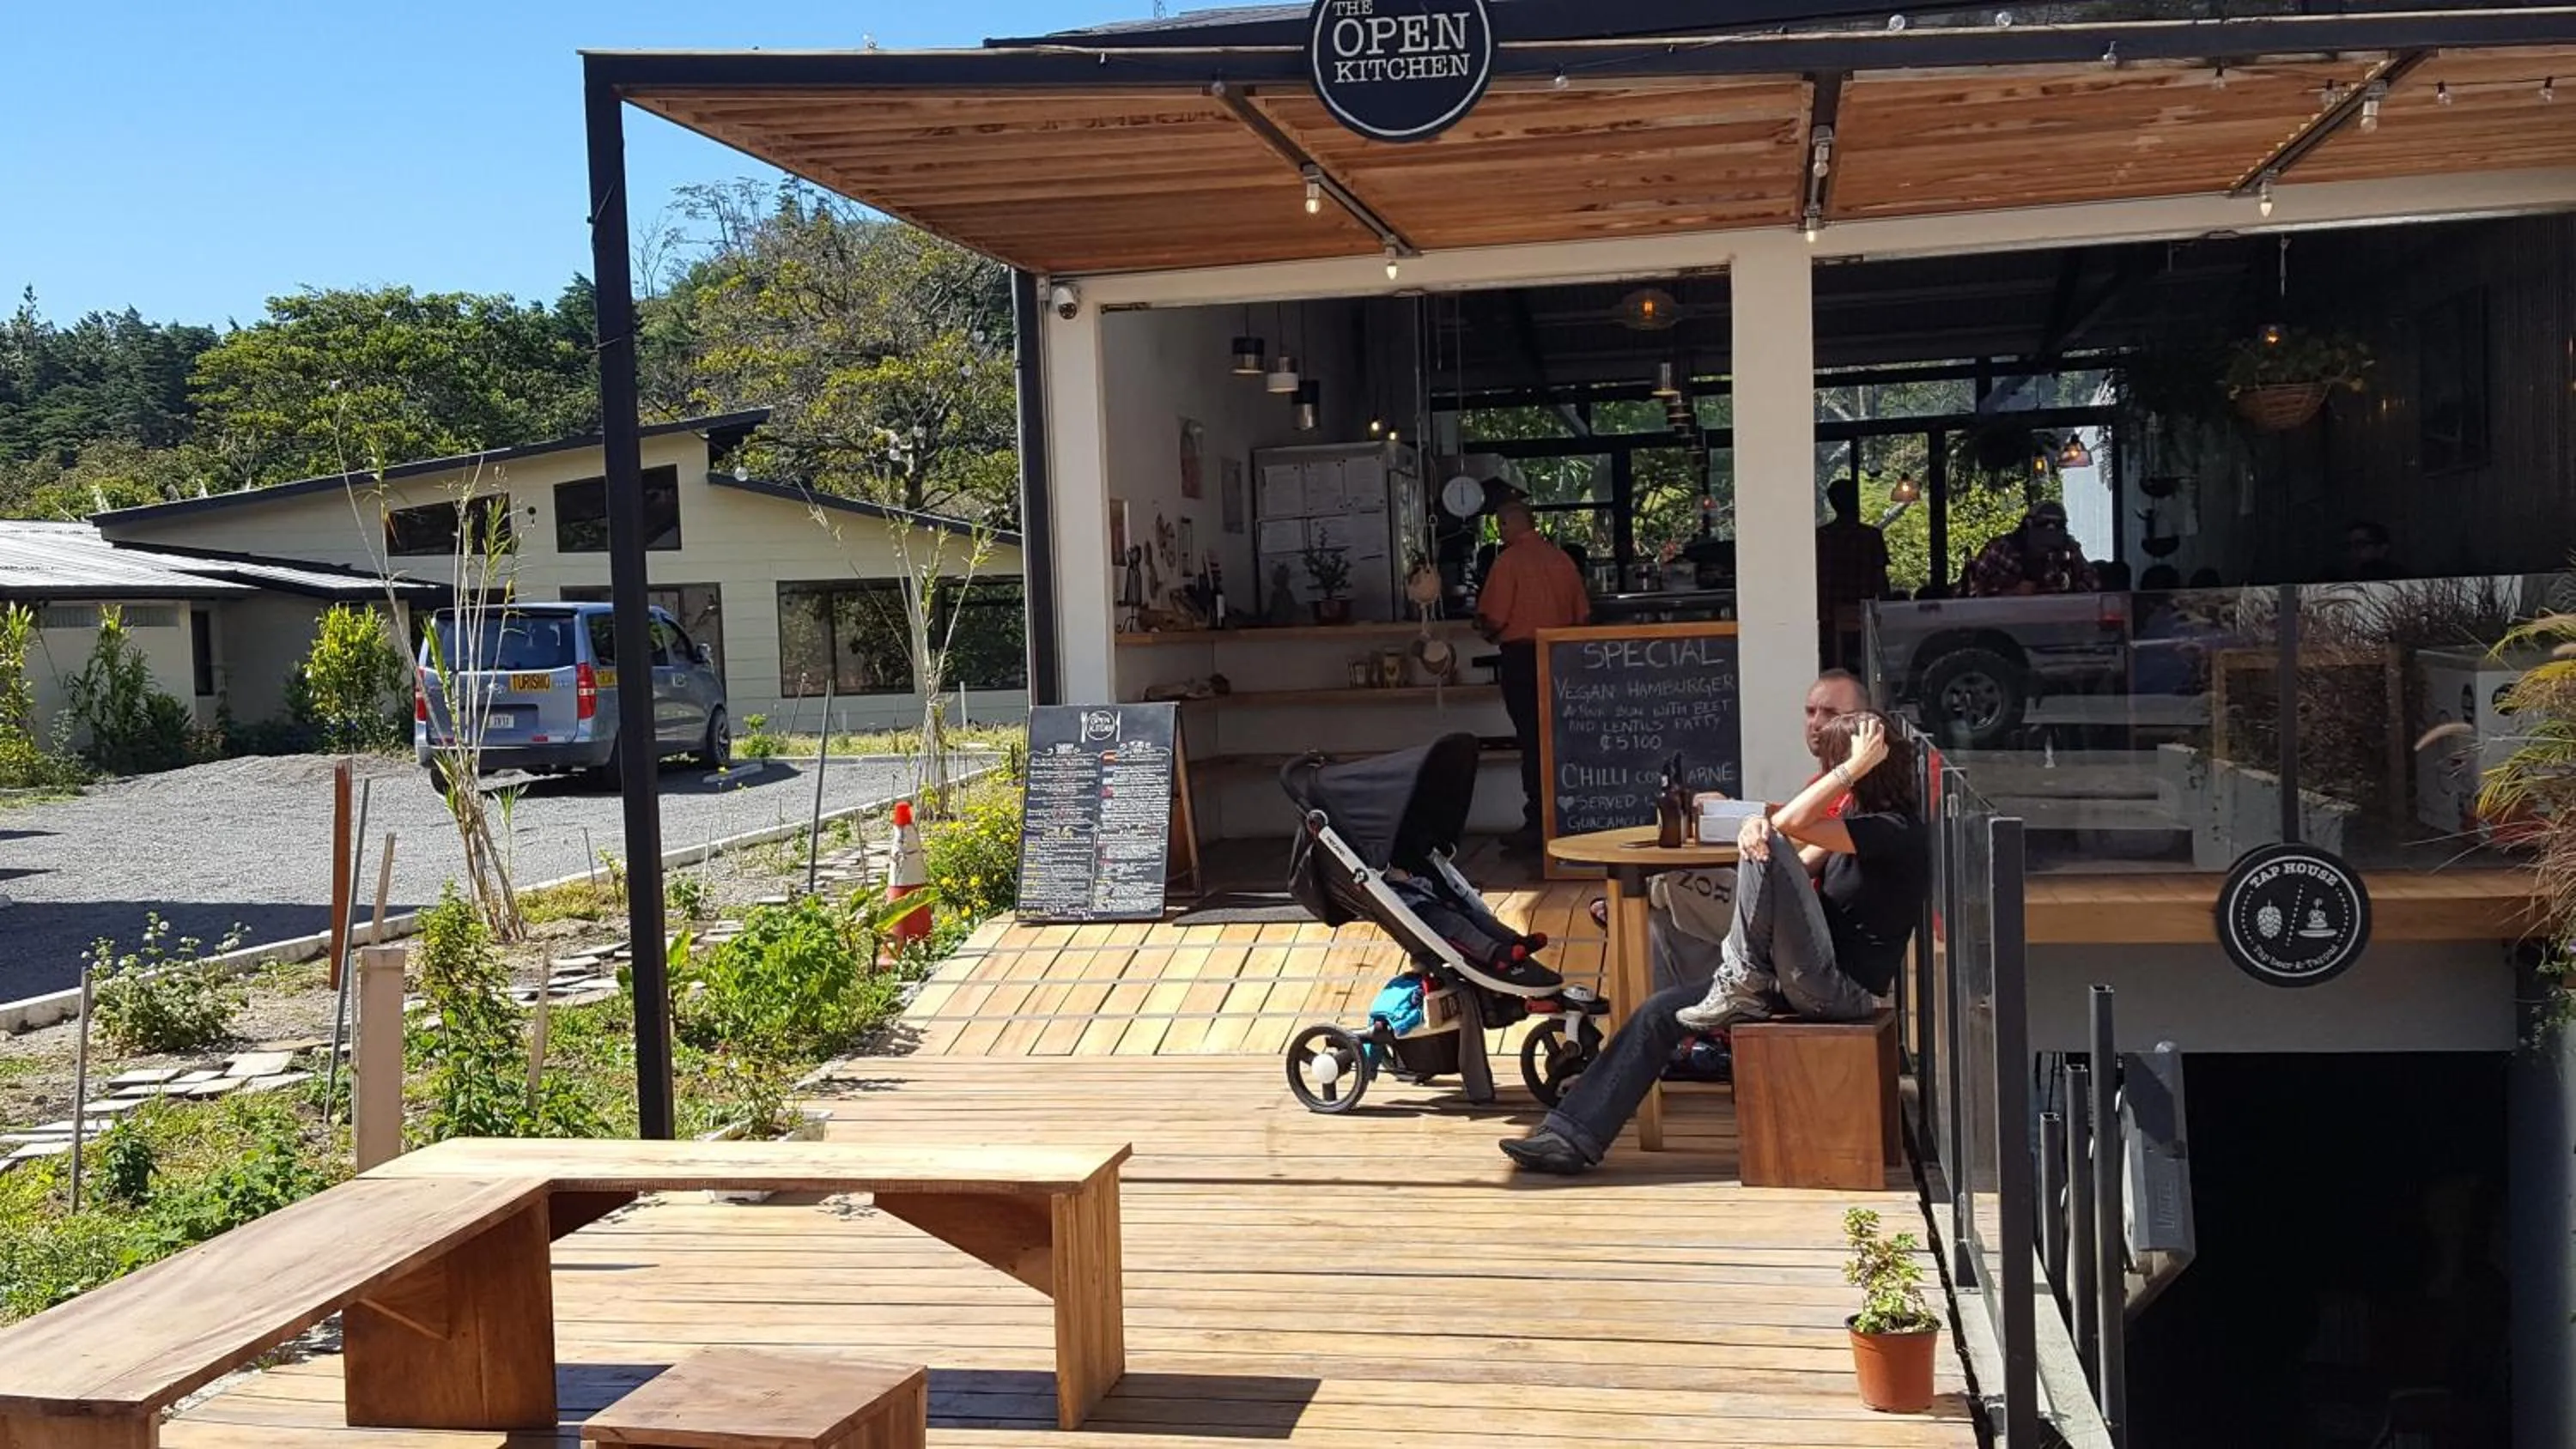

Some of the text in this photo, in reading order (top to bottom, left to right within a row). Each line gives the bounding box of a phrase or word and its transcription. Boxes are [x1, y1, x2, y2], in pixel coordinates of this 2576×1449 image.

[1334, 0, 1373, 15] THE
[1333, 13, 1470, 57] OPEN
[1334, 53, 1470, 83] KITCHEN
[1584, 639, 1724, 669] SPECIAL
[1553, 674, 1736, 703] VEGAN HAMBURGER
[1562, 762, 1627, 789] CHILLI
[1685, 762, 1735, 784] ARNE
[1575, 795, 1638, 811] SERVED
[2250, 863, 2338, 888] TAP HOUSE
